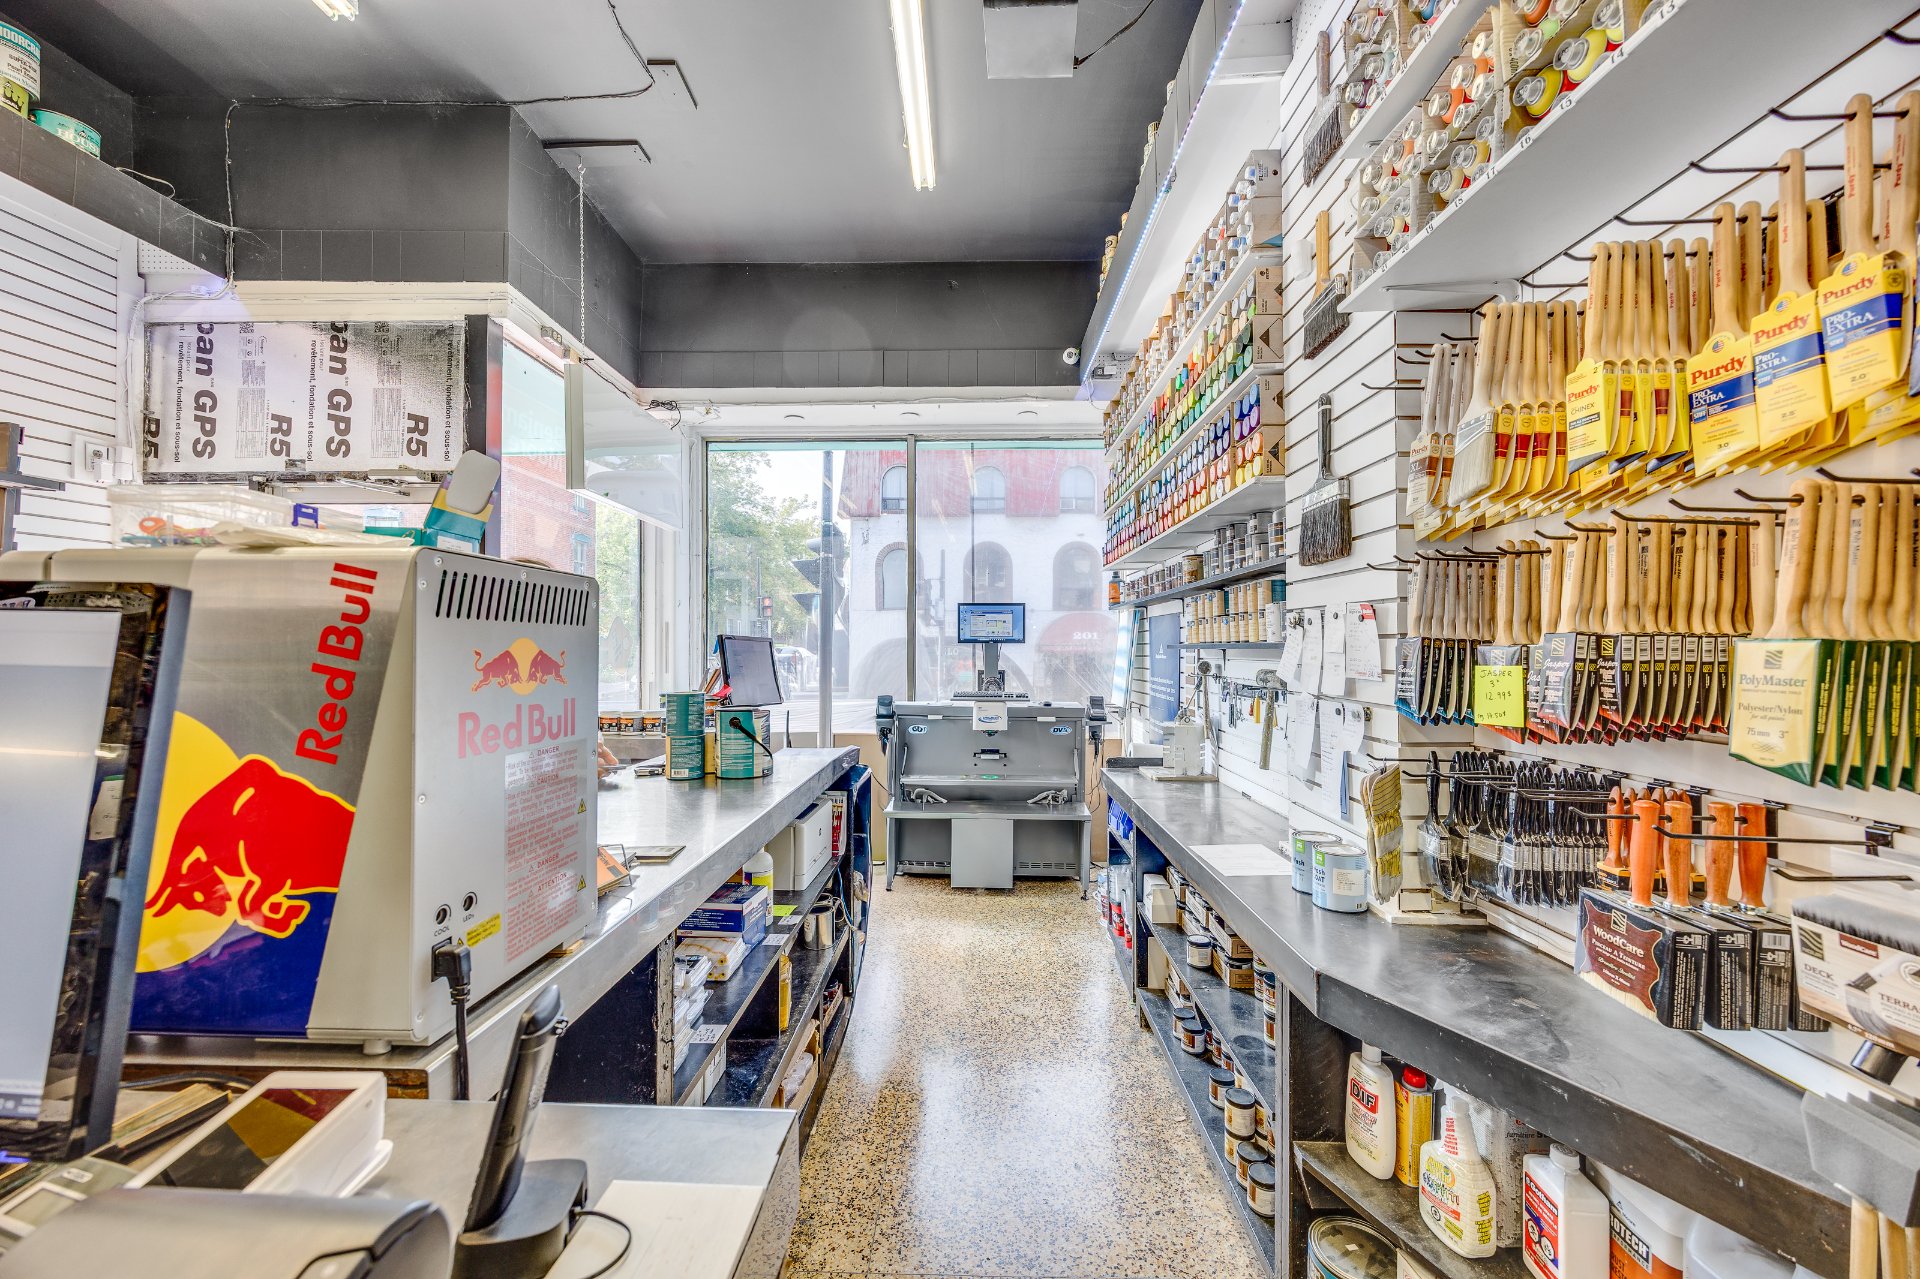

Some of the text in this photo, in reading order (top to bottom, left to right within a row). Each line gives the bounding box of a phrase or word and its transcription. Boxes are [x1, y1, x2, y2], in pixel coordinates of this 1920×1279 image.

[1823, 275, 1876, 304] Purdy
[1825, 310, 1856, 327] PRO-
[1827, 312, 1874, 337] EXTRA
[1753, 314, 1811, 345] Purdy
[1754, 352, 1779, 364] PRO-
[1755, 356, 1787, 373] EXTRA
[1691, 355, 1746, 385] Purdy
[1568, 384, 1598, 402] Purdy
[1692, 389, 1713, 401] PRO-
[1693, 392, 1724, 408] EXTRA
[176, 386, 184, 421] fondation
[308, 385, 317, 420] fondation
[1570, 402, 1595, 416] CHINEX
[192, 389, 218, 460] GPS
[308, 421, 314, 429] et
[325, 388, 352, 458] GPS
[269, 413, 293, 458] R5
[406, 412, 429, 458] R5
[1411, 443, 1428, 457] Purdy
[296, 562, 378, 765] Red Bull
[1480, 670, 1512, 679] JASPER
[1739, 673, 1807, 688] PolyMaster
[1738, 703, 1803, 716] Polyester/Nylon
[458, 698, 576, 759] Red Bull
[537, 746, 560, 756] DANGER
[537, 853, 560, 869] DANGER
[538, 872, 567, 891] ATTENTION
[434, 926, 450, 937] COOL
[1593, 924, 1645, 958] WoodCare
[1804, 963, 1834, 981] DECK
[1352, 1082, 1375, 1109] DIF
[1505, 1130, 1535, 1138] furniture
[1530, 1183, 1558, 1216] Gotham
